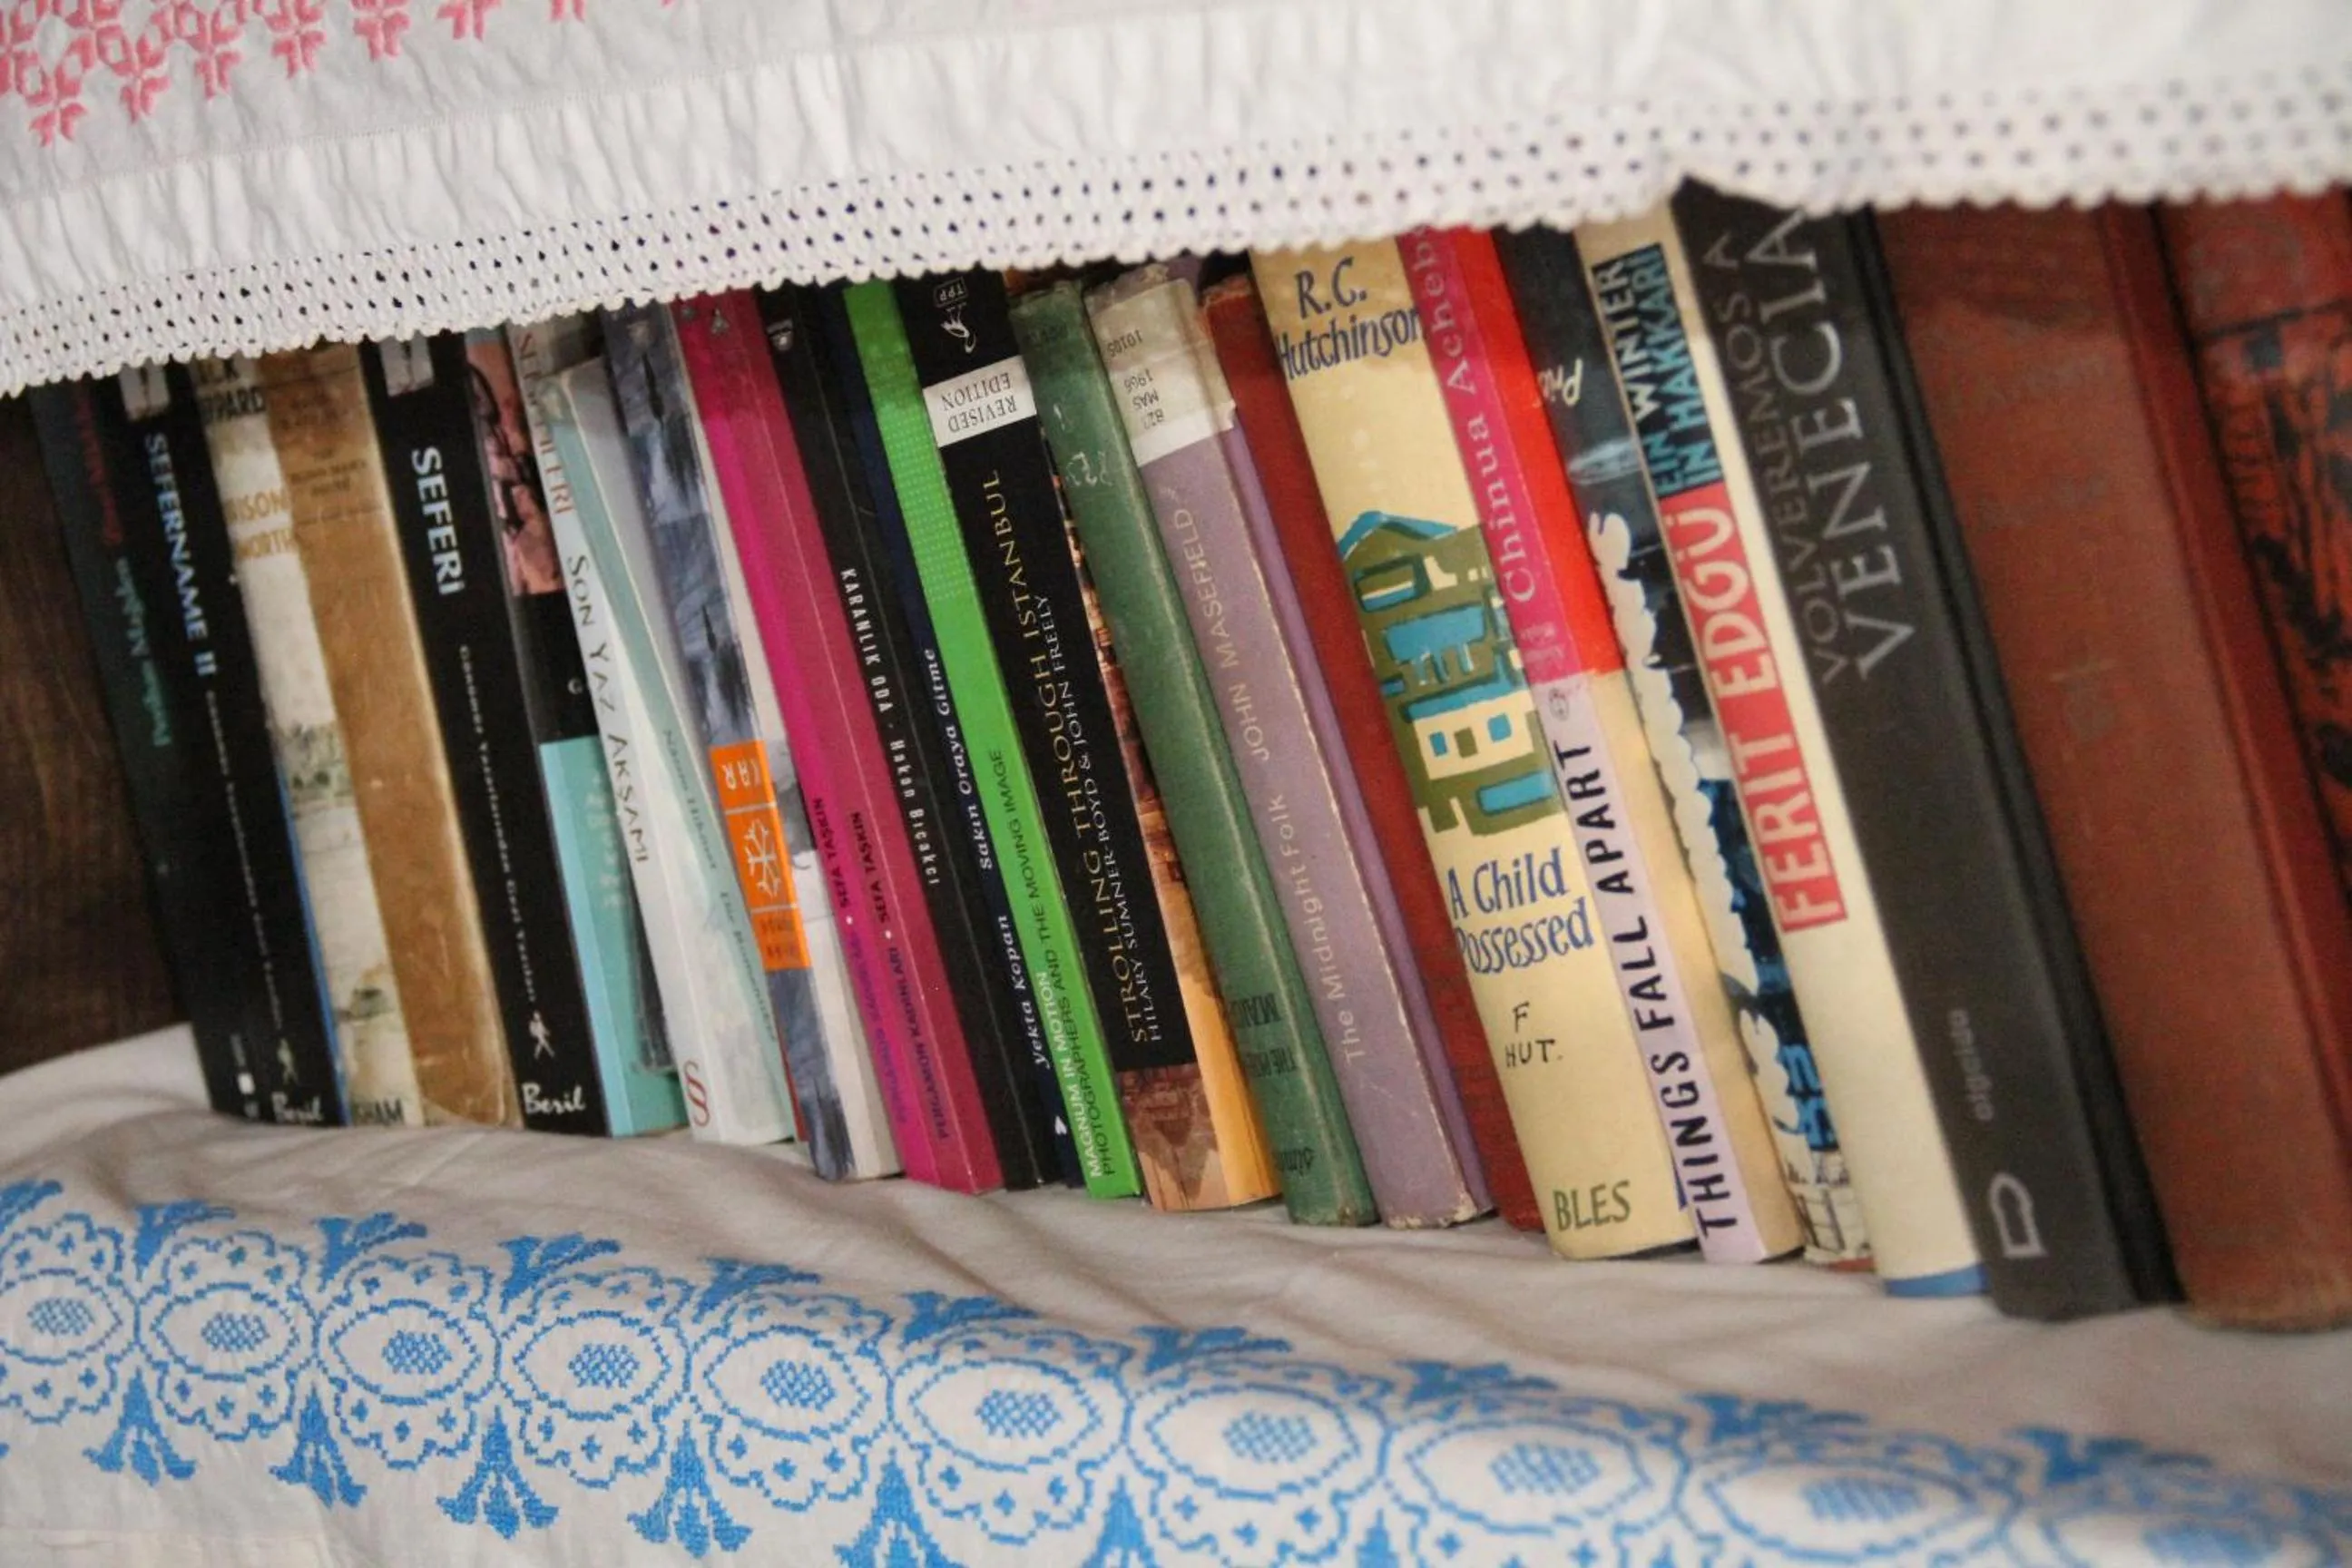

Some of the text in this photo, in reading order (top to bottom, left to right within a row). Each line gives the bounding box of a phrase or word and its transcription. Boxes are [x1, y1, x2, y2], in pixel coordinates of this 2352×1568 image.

[941, 373, 1011, 413] EDITION
[948, 394, 1018, 433] REVISED
[1132, 390, 1160, 411] MAS
[1594, 262, 1684, 496] EIN WINTER
[1680, 448, 1722, 486] IN
[1702, 236, 1849, 684] VOLVEREMOS A
[1745, 211, 1915, 680] VENECIA
[145, 433, 218, 677] SEFERNAME II
[1468, 416, 1535, 603] Chinua
[840, 568, 883, 666] KARANLIK
[870, 675, 894, 713] ODA
[889, 739, 916, 799] Hakan
[924, 648, 951, 716] Gitme
[1174, 508, 1270, 762] JOHN MASEFIELD
[945, 725, 974, 797] Oraya
[982, 468, 1149, 1044] STROLLING THROUGH ISTANBUL
[1675, 505, 1842, 927] FERIT EDGÜ
[1034, 593, 1163, 1043] HILARY SUMNER-BOYD & JOHN FREELY
[831, 867, 851, 909] SEFA
[868, 880, 892, 925] SEFA
[1269, 795, 1363, 1063] The Midnight Folk
[1447, 847, 1569, 921] A Child
[990, 750, 1116, 1178] PHOTOGRAPHERS AND THE MOVING IMAGE
[996, 915, 1027, 992] Kopan
[1453, 898, 1594, 975] Possessed
[1512, 1001, 1531, 1034] F
[1553, 741, 1739, 1239] THINGS FALL APART
[522, 1083, 587, 1117] Beril
[913, 1041, 950, 1140] PERGAMON
[1035, 969, 1104, 1179] MAGNUM IN MOTION
[1553, 1181, 1632, 1231] BLES
